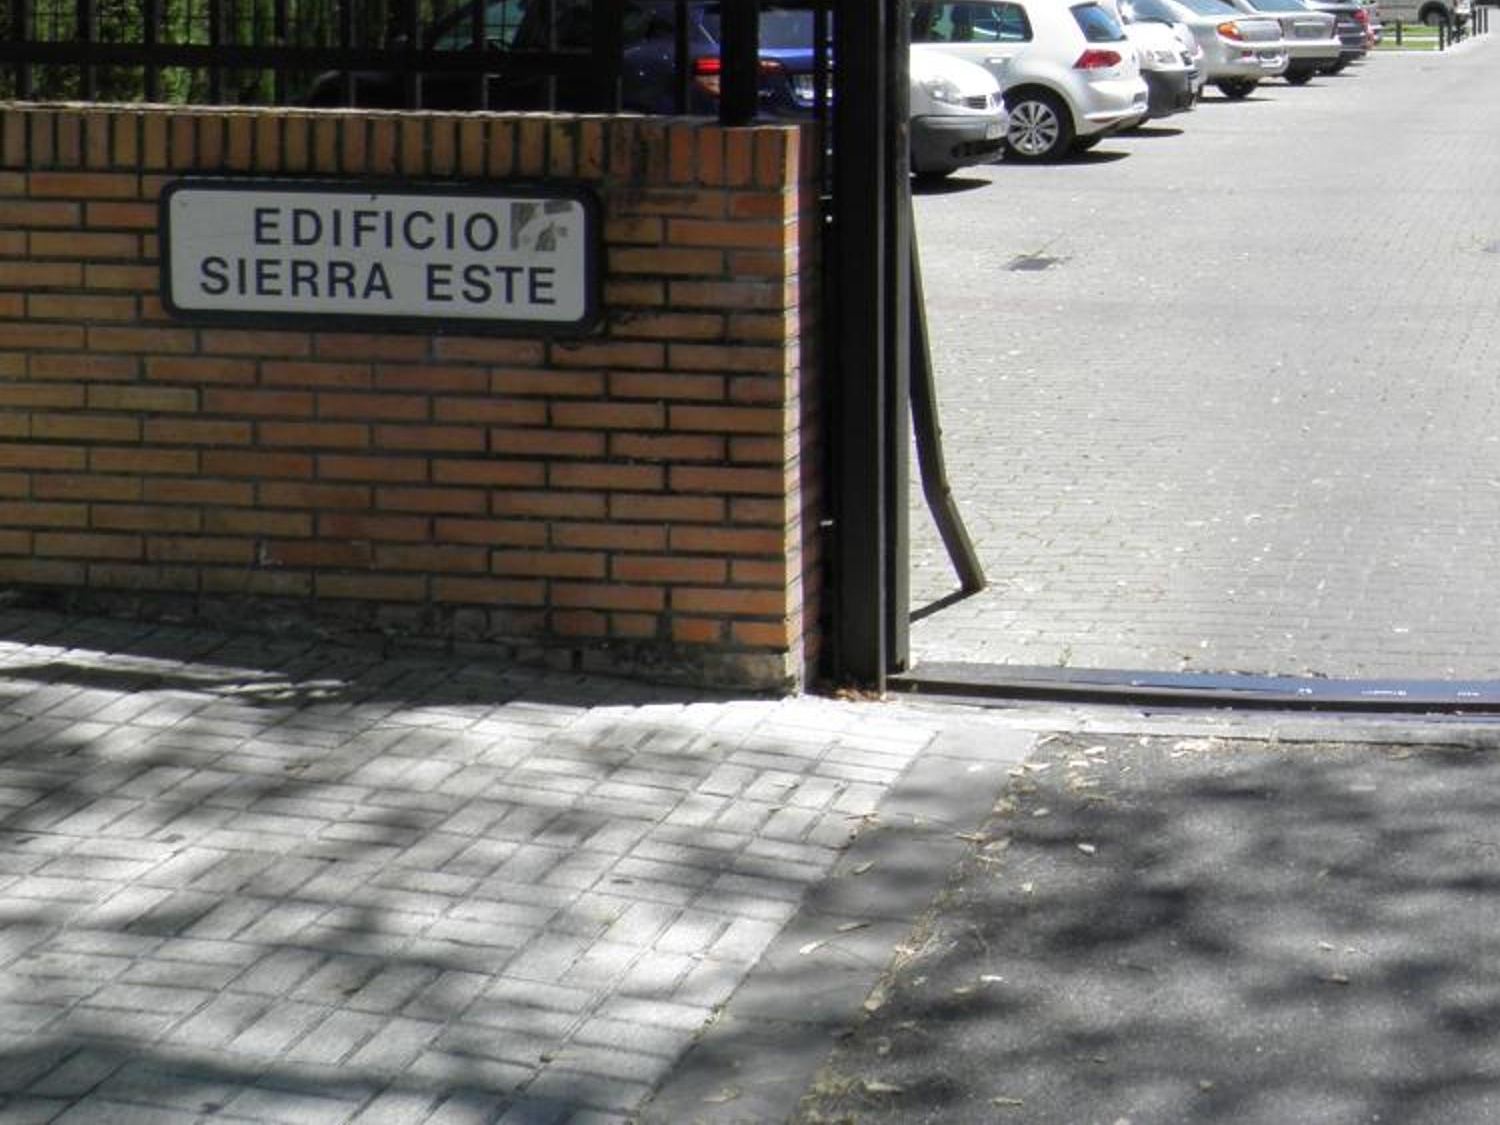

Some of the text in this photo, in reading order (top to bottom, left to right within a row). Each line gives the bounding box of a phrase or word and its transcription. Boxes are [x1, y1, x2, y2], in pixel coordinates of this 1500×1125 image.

[254, 207, 499, 252] EDIFICIO
[199, 256, 557, 306] SIERRA ESTE
